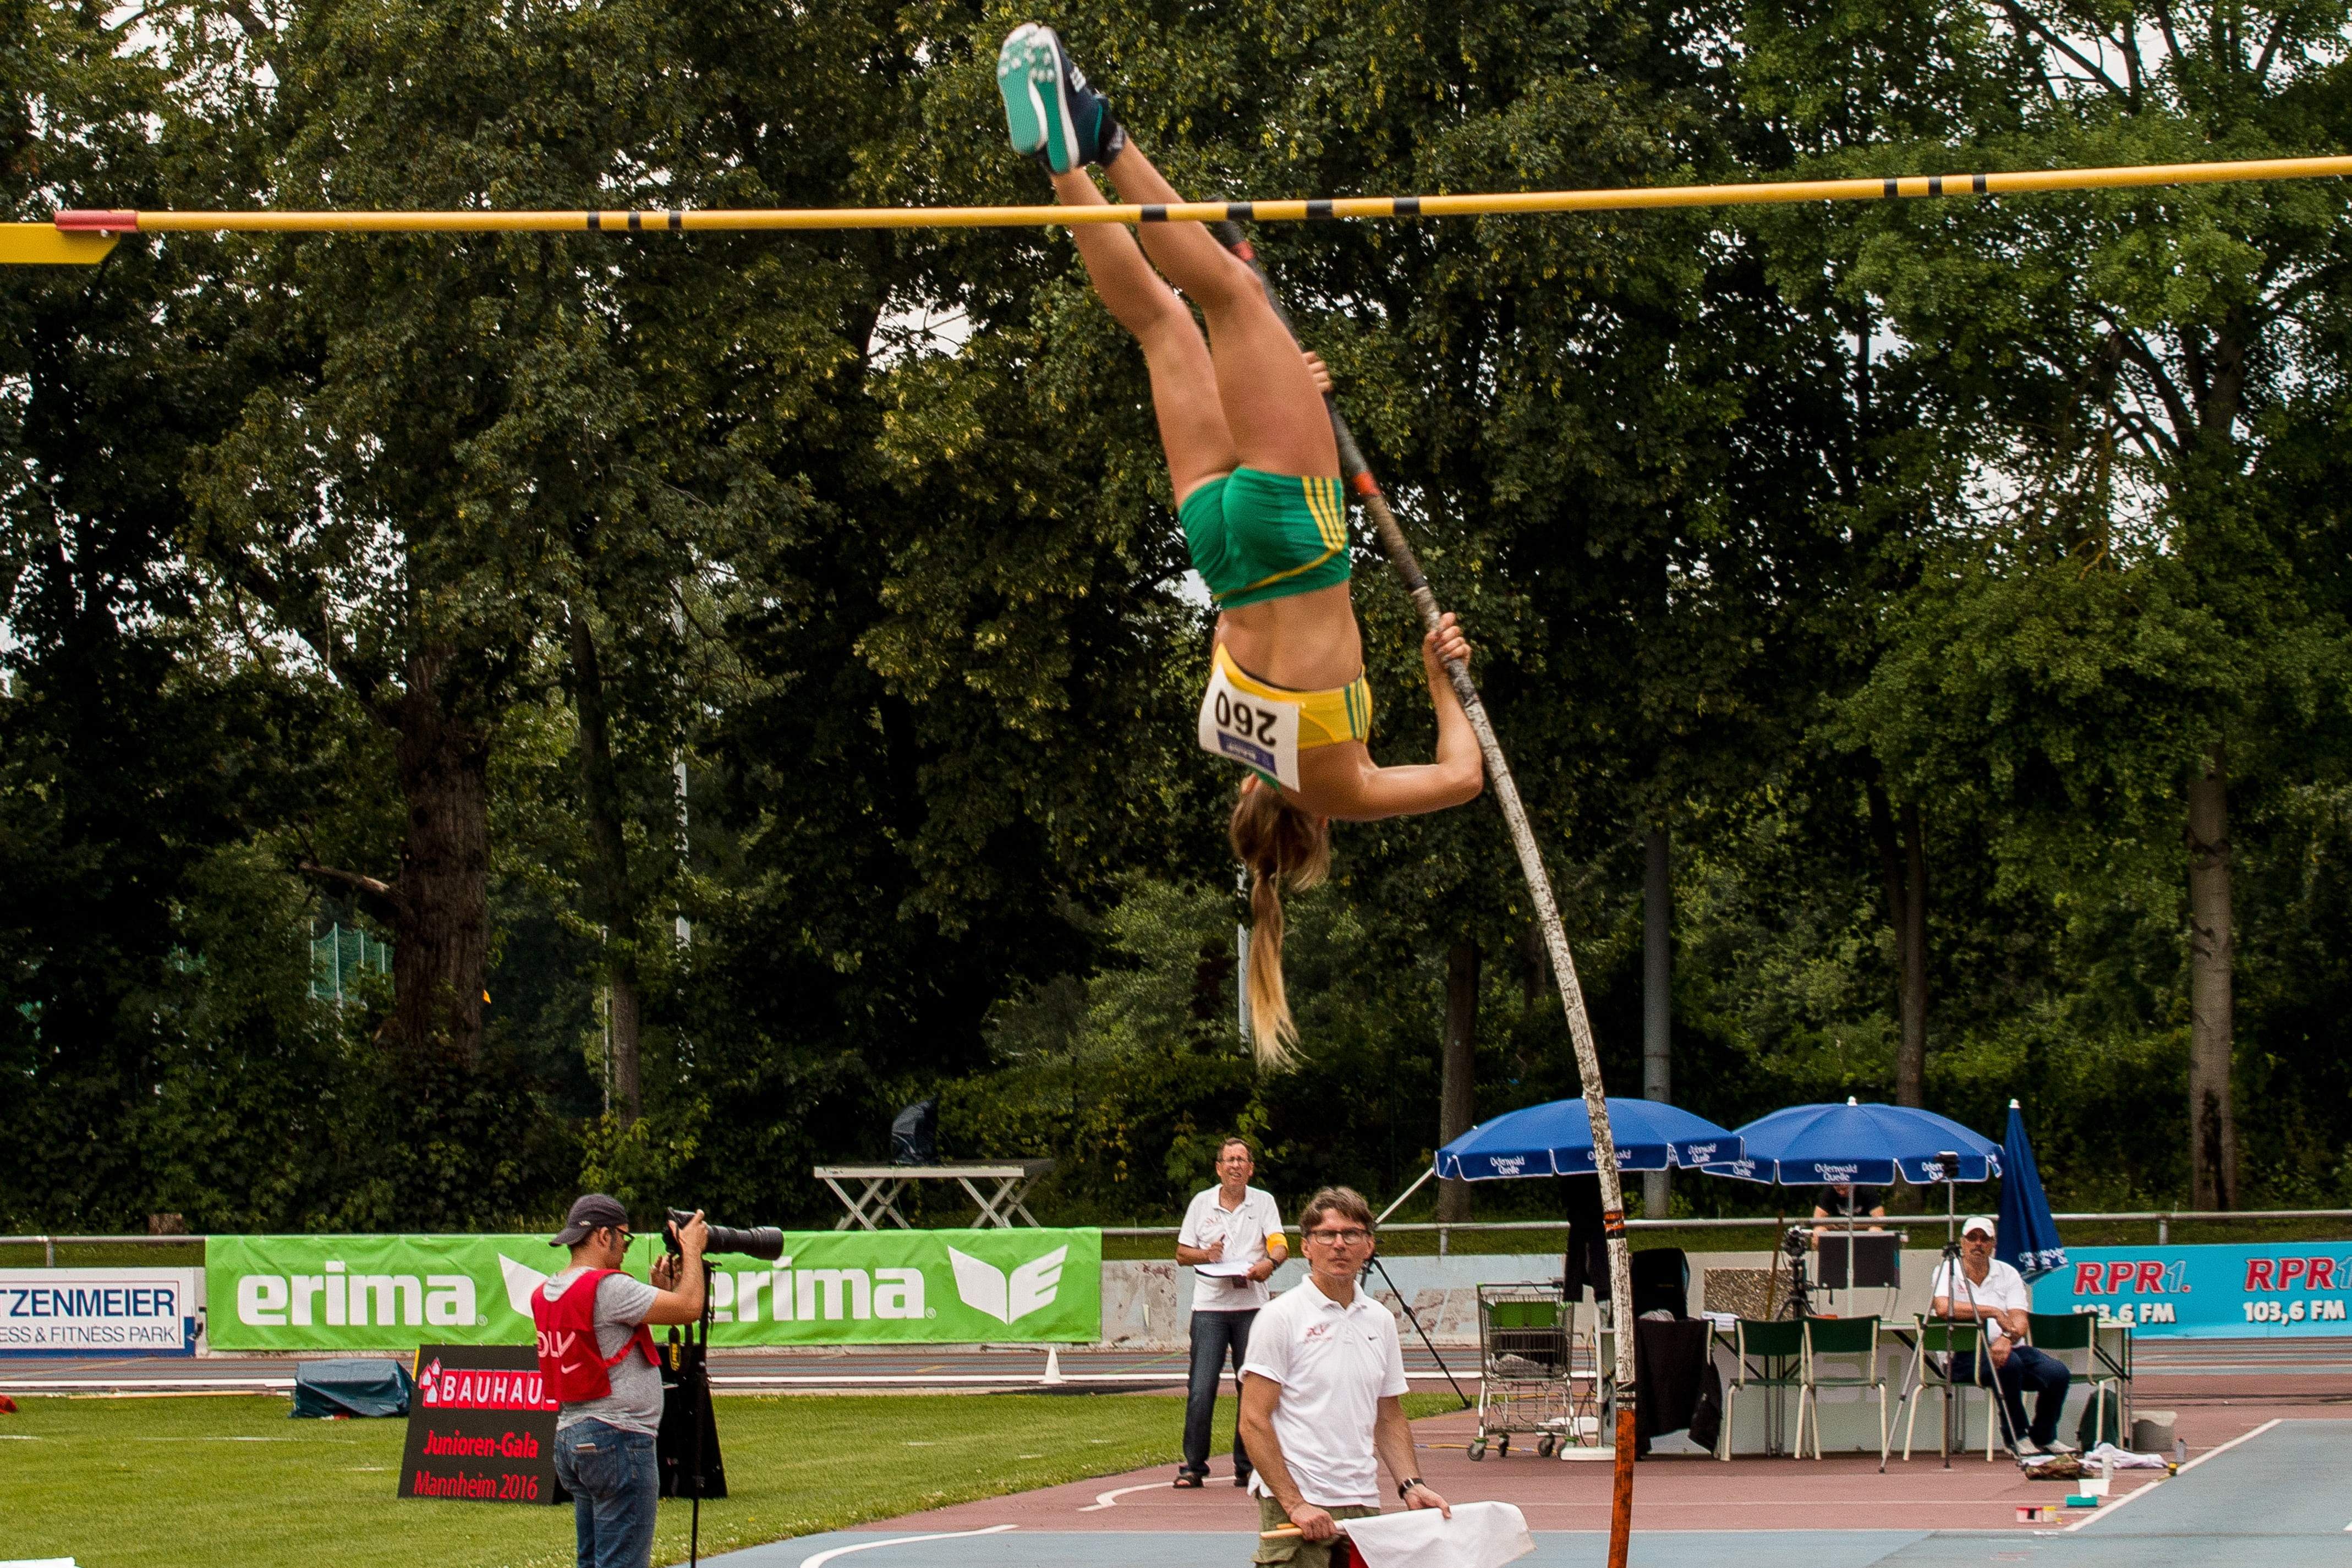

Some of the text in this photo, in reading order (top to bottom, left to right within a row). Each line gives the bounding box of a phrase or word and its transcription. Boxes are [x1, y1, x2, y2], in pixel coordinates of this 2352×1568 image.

[1215, 690, 1277, 747] 260
[238, 1260, 476, 1325] erima
[2140, 1303, 2176, 1323] FM
[2243, 1300, 2346, 1326] 103,6 FM
[35, 1327, 46, 1342] &
[51, 1326, 125, 1343] FITNESS
[129, 1326, 176, 1342] PARK
[442, 1375, 558, 1405] BAUHAU
[423, 1430, 539, 1458] Junioren-Gala
[413, 1470, 538, 1499] Mannheim 2016
